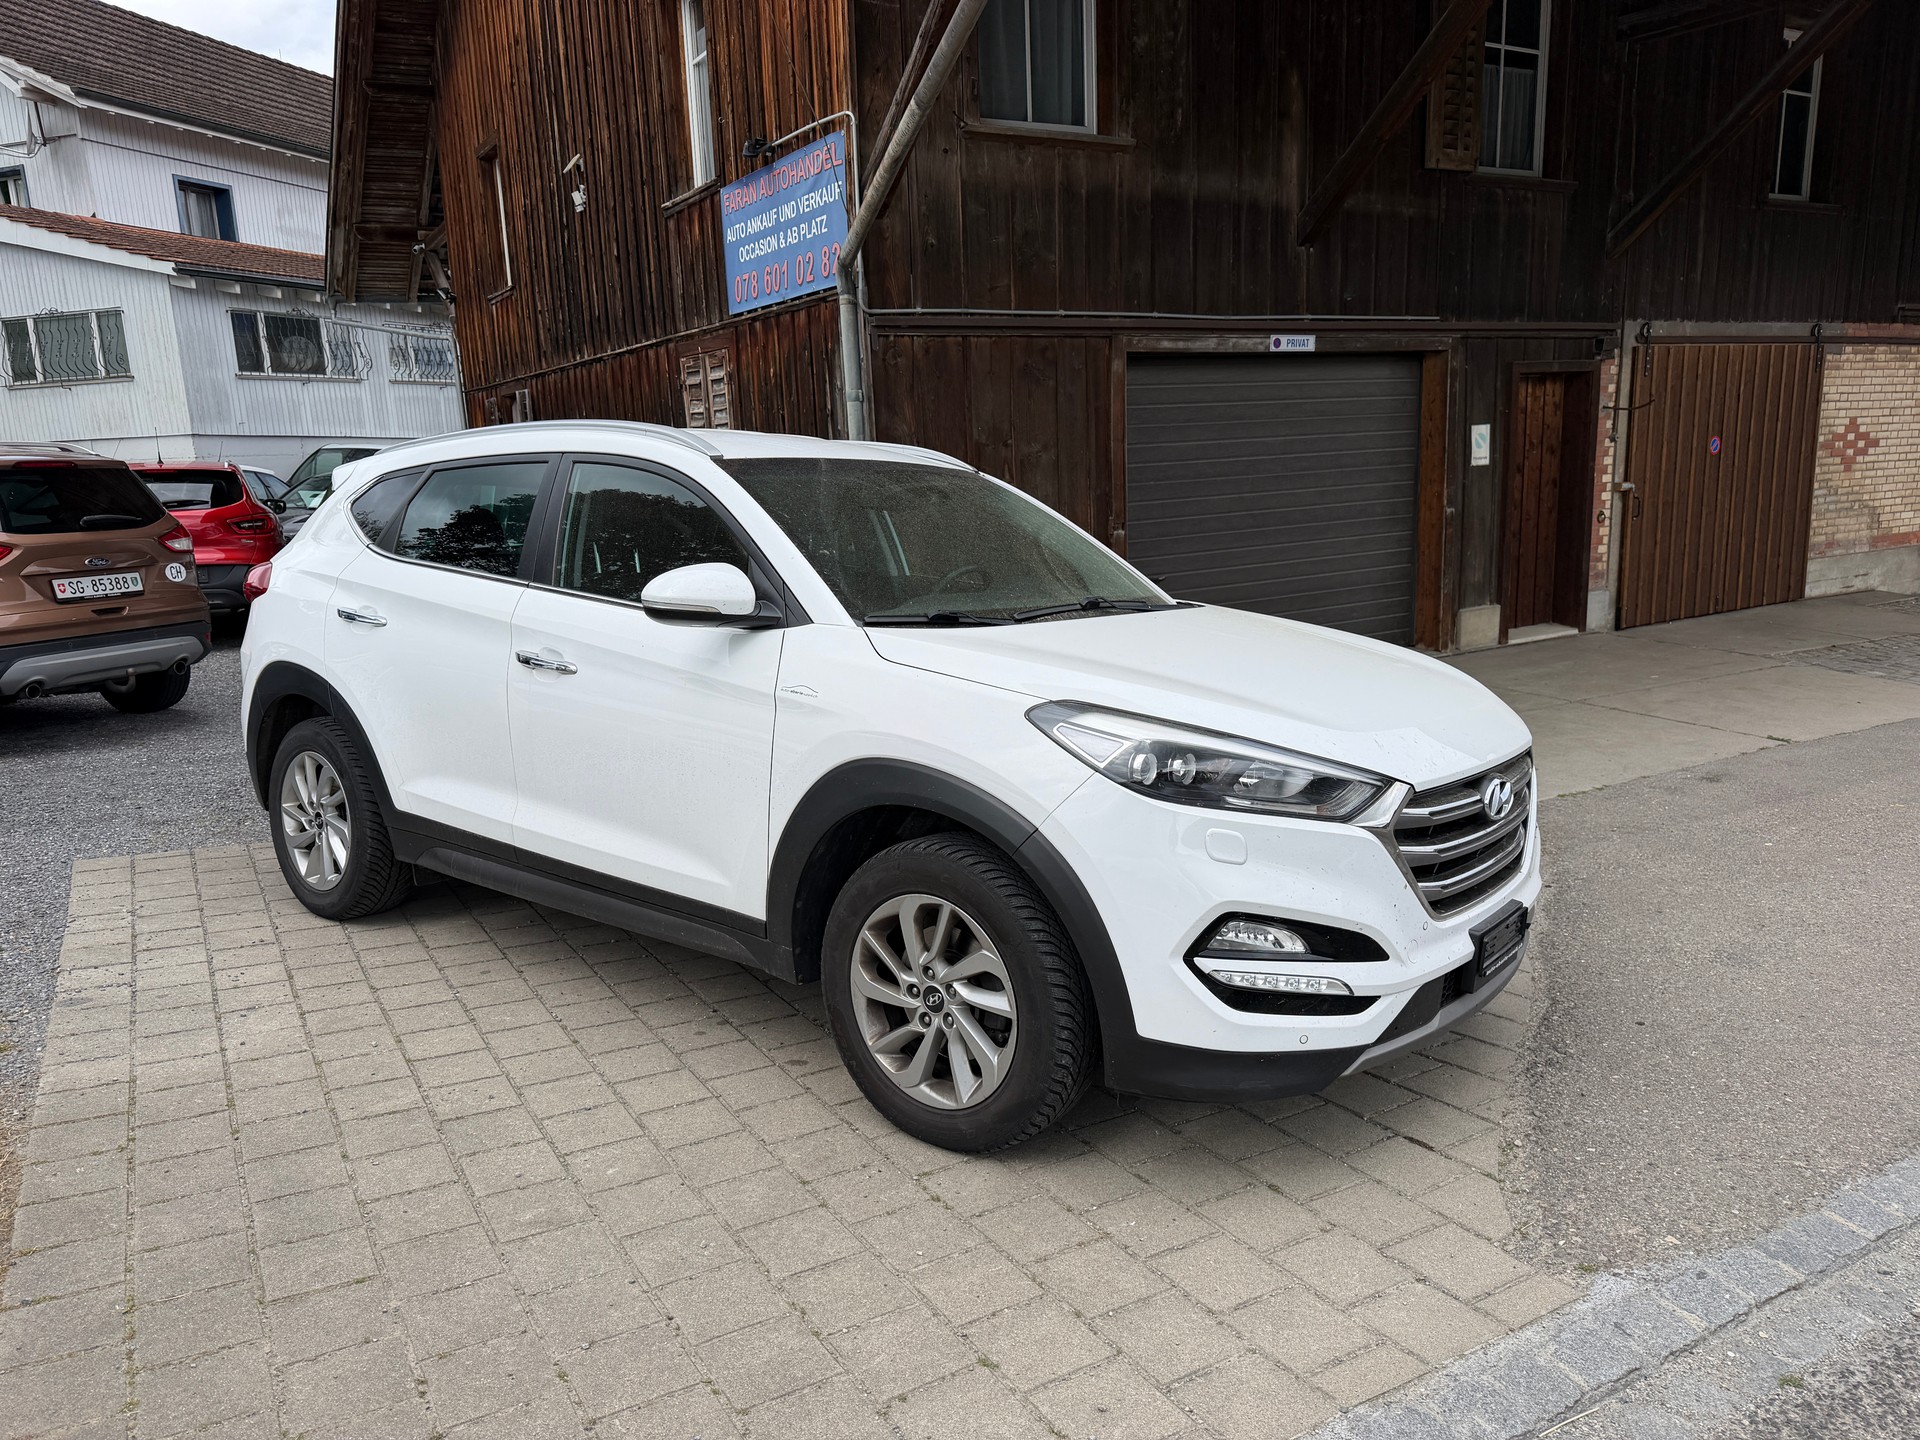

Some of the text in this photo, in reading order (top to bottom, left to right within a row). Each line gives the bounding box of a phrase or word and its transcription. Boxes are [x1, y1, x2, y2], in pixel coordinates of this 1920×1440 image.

[724, 142, 843, 215] FARAN AUTOHANDEL
[727, 181, 843, 244] AUTO ANKAUF UND VERKAUF
[739, 215, 828, 263] OCCASION & AB PLATZ
[735, 241, 841, 303] 078 601 02 82
[1286, 338, 1310, 348] PRIVAT
[170, 565, 183, 580] CH
